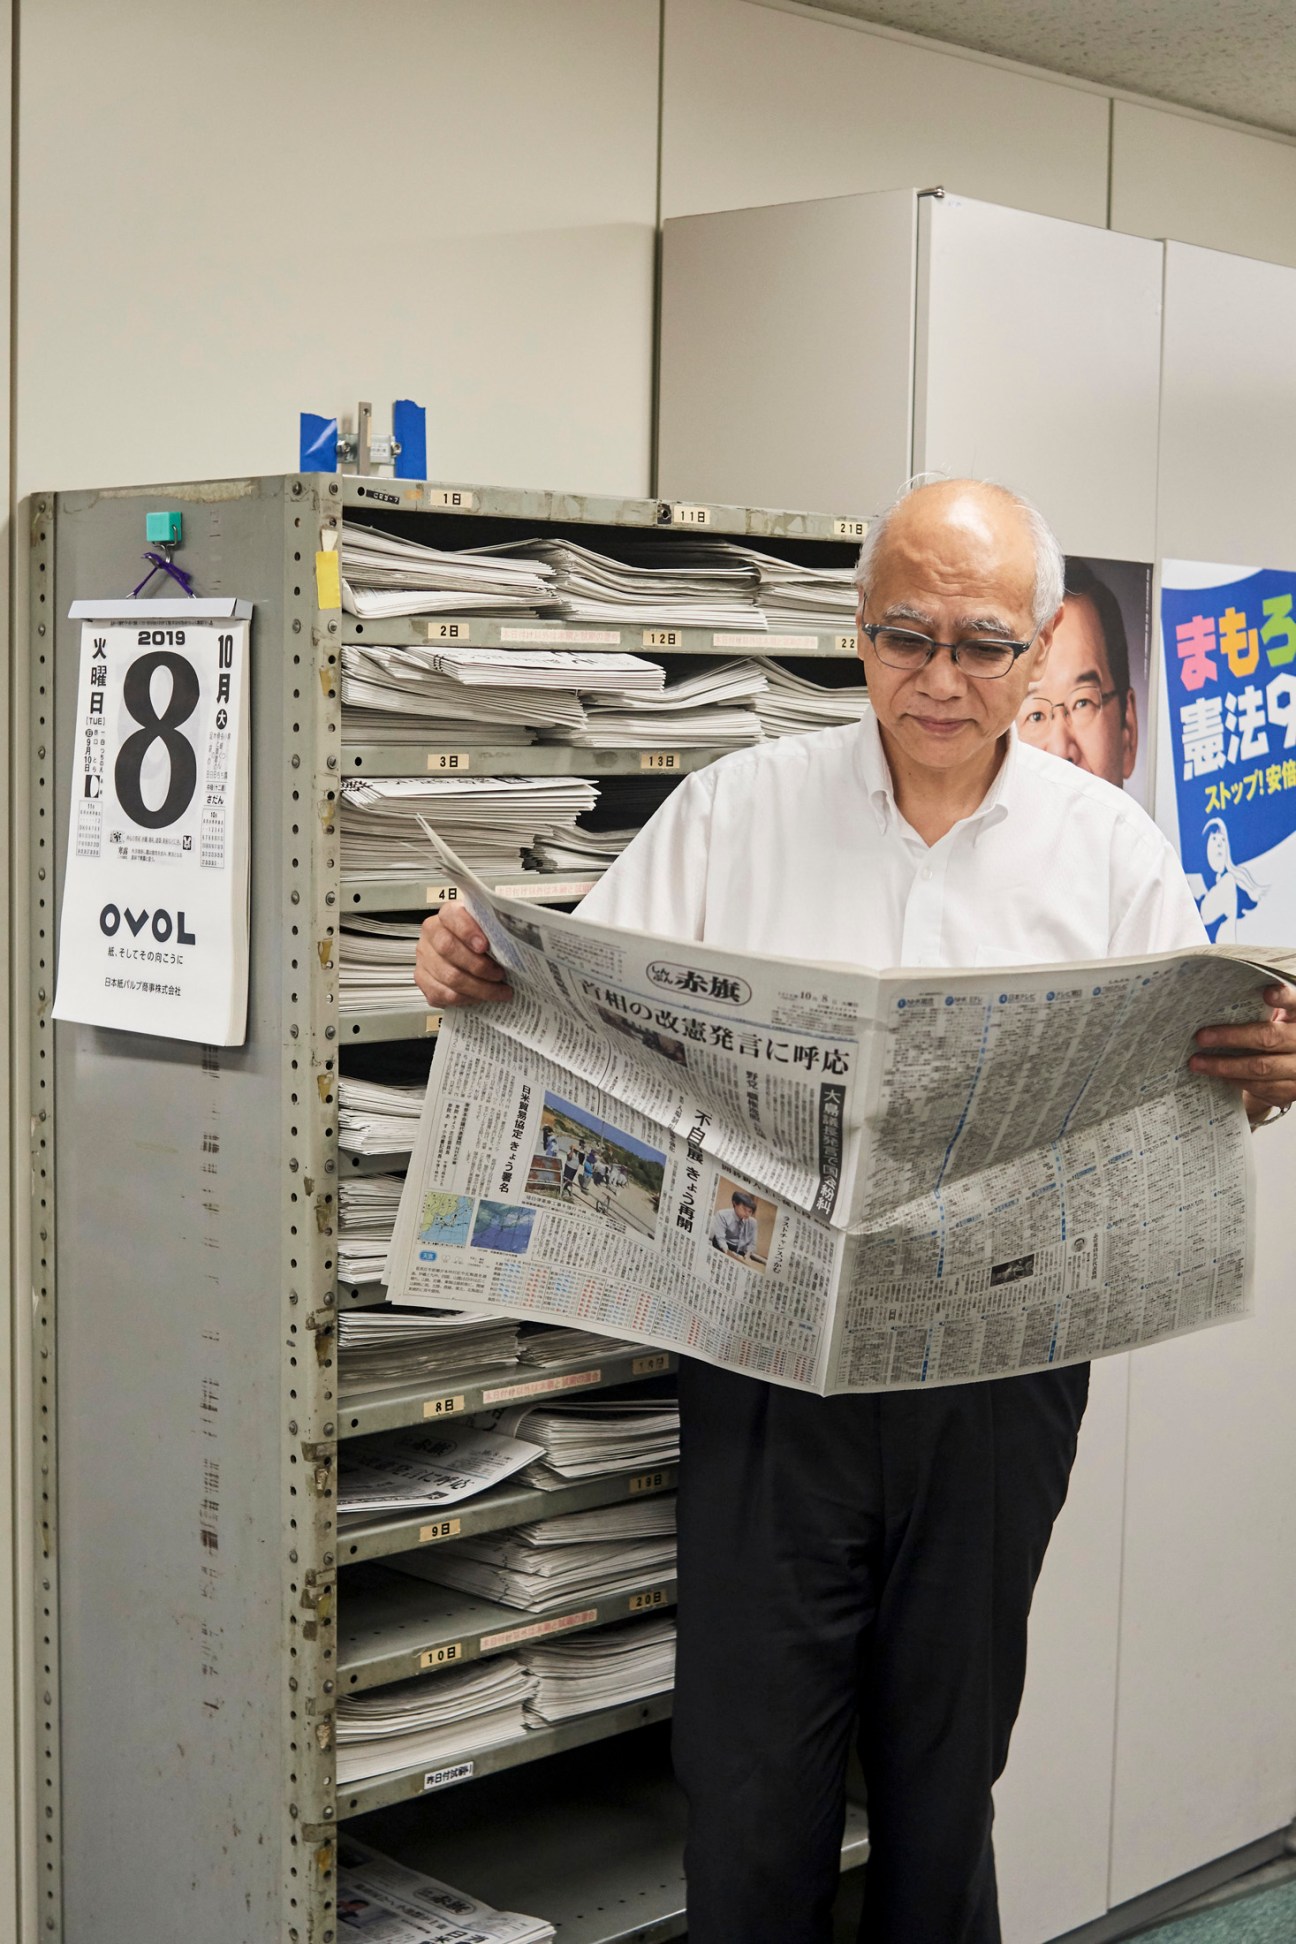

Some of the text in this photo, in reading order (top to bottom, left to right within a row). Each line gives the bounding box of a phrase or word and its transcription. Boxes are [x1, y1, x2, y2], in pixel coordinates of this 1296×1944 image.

[443, 493, 461, 505] 1日
[680, 511, 705, 523] 11日
[840, 523, 863, 535] 21日
[138, 631, 186, 645] 2019
[440, 625, 459, 638] 2日
[650, 633, 676, 645] 12日
[90, 637, 107, 714] 火曜日
[216, 634, 234, 704] 10月
[114, 650, 200, 829] 8
[440, 755, 458, 768] 3日
[649, 755, 674, 767] 13日
[438, 887, 457, 900] 4日
[100, 903, 196, 945] OVOL
[104, 976, 182, 997] 日本紙パルプ商事株式会社
[436, 1399, 453, 1412] 8日
[638, 1474, 662, 1488] 19日
[432, 1522, 449, 1537] 9日
[636, 1592, 661, 1606] 20日
[428, 1647, 456, 1663] 10日
